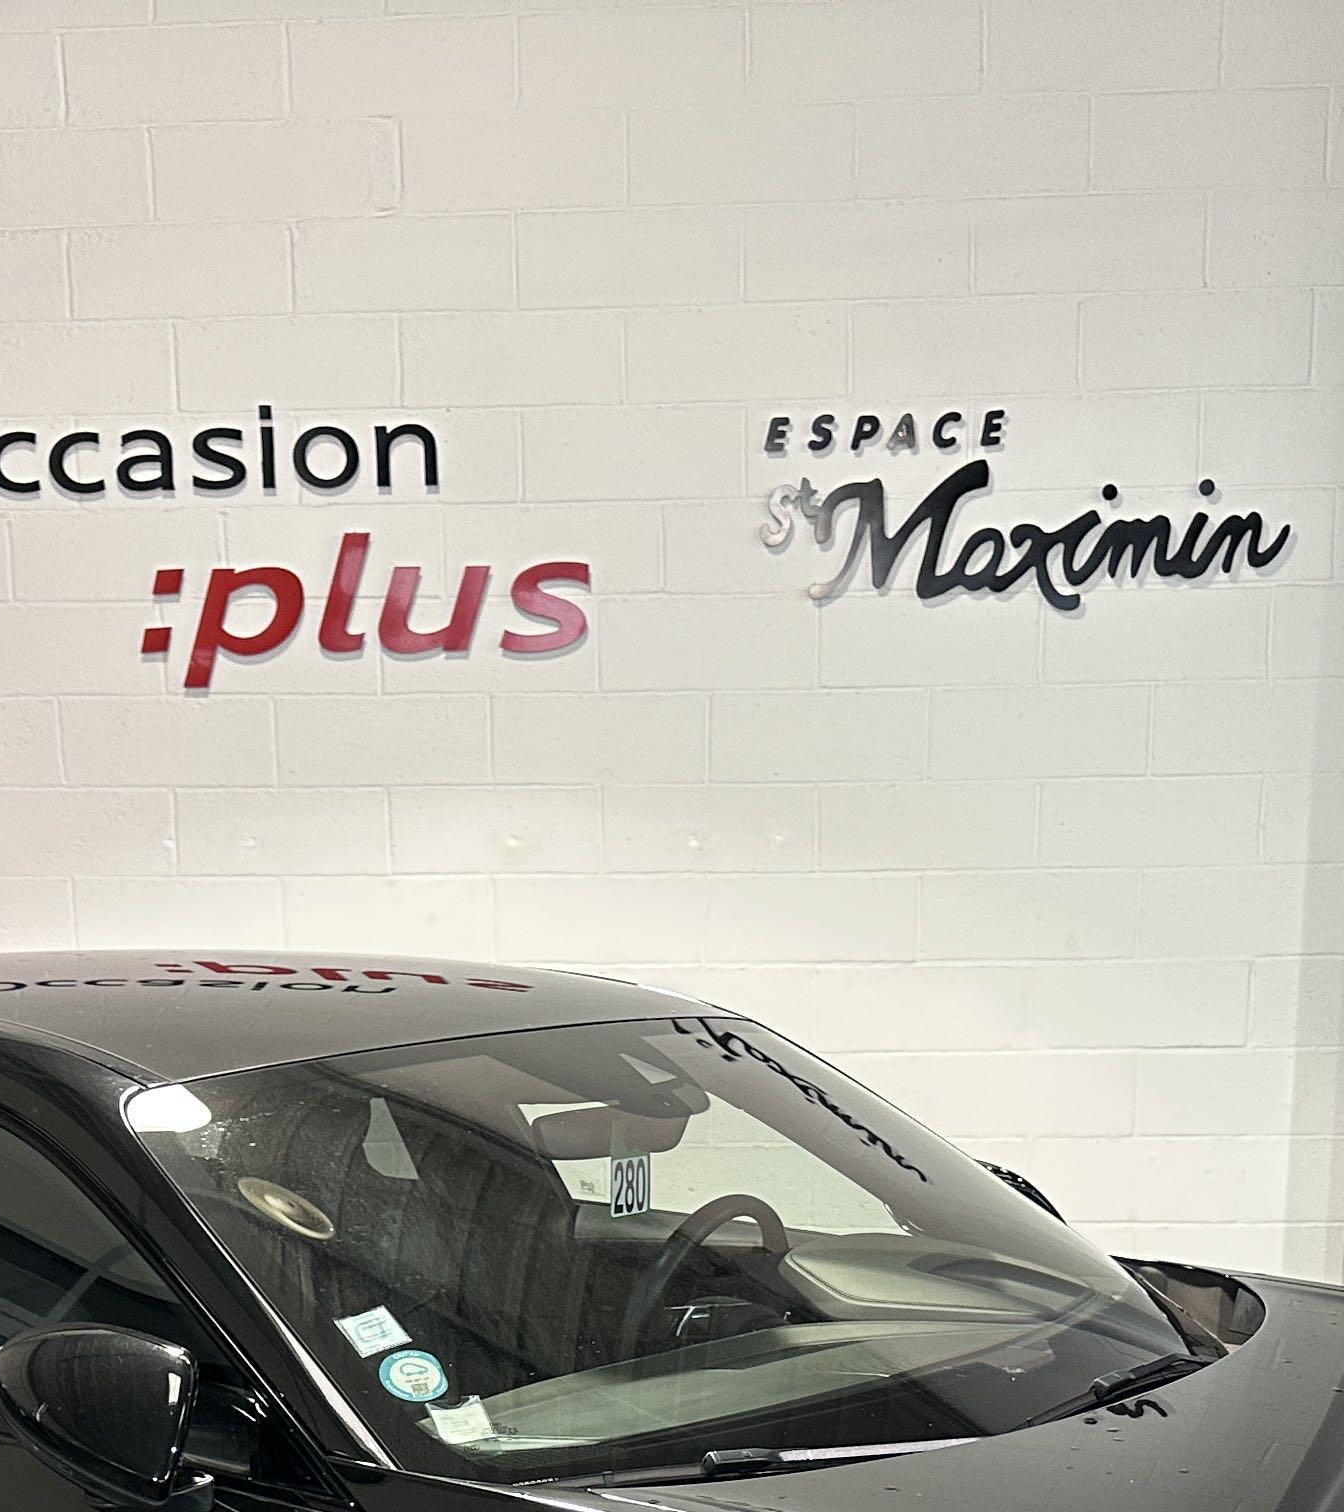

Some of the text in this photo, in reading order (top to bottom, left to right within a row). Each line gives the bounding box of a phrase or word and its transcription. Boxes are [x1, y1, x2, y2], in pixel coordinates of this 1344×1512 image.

[763, 410, 1006, 453] ESPACE
[809, 459, 1291, 611] Maximin
[140, 532, 592, 689] :plus
[613, 1158, 646, 1215] 280
